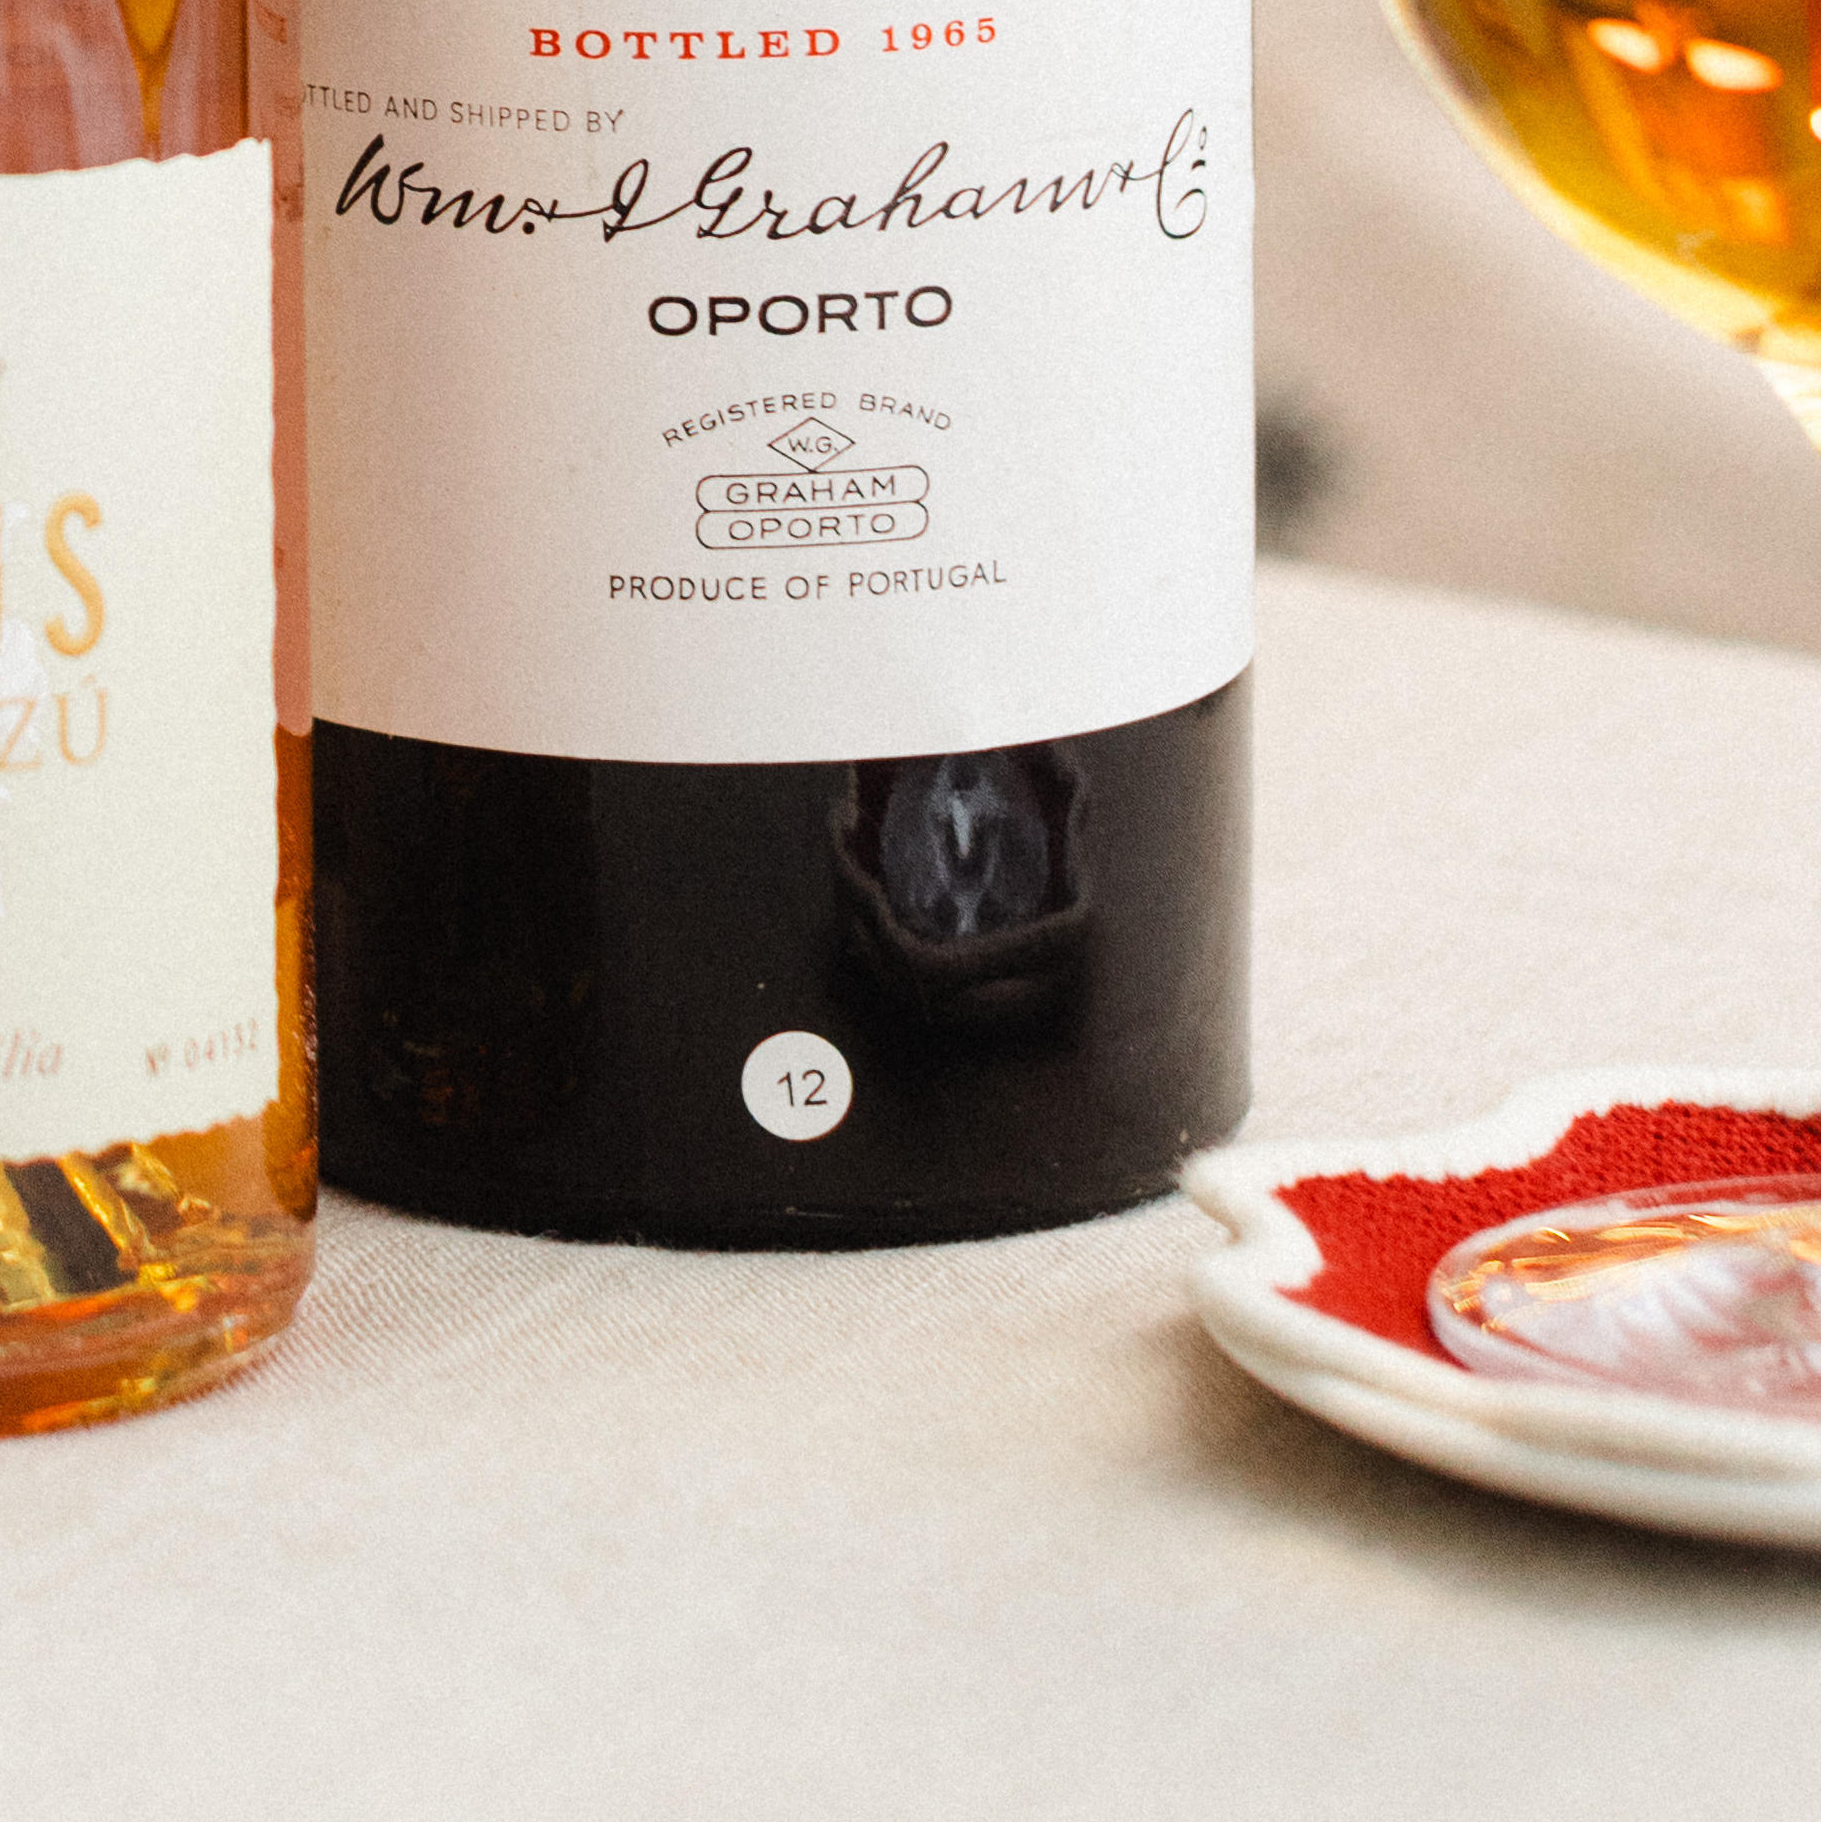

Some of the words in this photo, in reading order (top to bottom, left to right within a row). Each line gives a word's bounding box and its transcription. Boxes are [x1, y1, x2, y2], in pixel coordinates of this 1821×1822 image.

[527, 26, 842, 61] BOTTLED
[880, 15, 999, 55] 1965
[300, 82, 371, 114] TTLED
[384, 95, 438, 121] AND
[450, 101, 570, 132] SHIPPED
[587, 109, 624, 133] BY
[691, 141, 1099, 241] Graham
[646, 284, 954, 336] OPORTO
[661, 391, 838, 448] REGISTERED
[858, 392, 953, 432] BRAND
[787, 435, 840, 455] W.G.
[725, 473, 897, 506] GRAHAM
[727, 512, 897, 542] OPORTO
[608, 572, 768, 602] PRODUCE
[785, 574, 830, 601] OF
[848, 559, 1008, 598] PORTUGAL
[777, 1068, 828, 1108] 12
